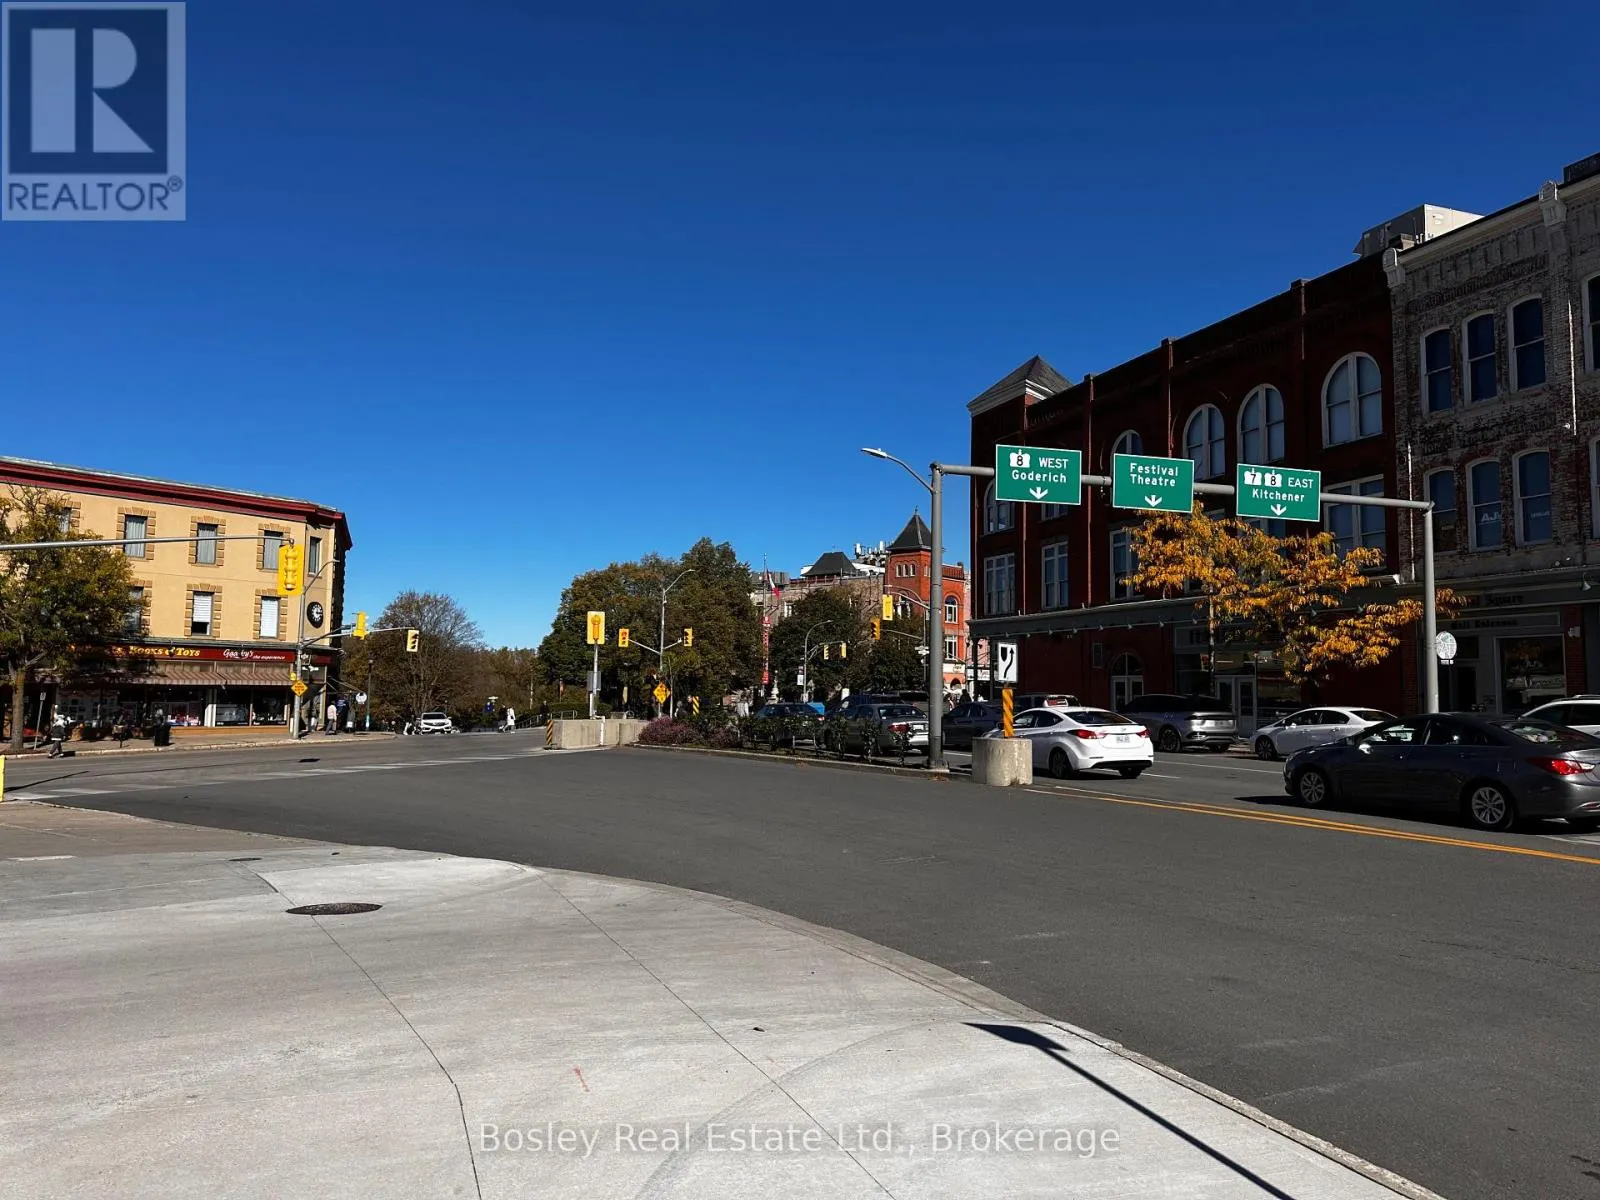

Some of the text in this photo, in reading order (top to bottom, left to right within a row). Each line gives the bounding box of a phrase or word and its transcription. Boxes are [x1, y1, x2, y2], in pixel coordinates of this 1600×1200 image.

[1016, 455, 1069, 469] 8 WEST
[1011, 469, 1067, 483] Goderich
[1130, 462, 1178, 477] Festival
[1130, 473, 1176, 487] Theatre
[1250, 473, 1314, 489] 7 8 EAST
[1252, 488, 1305, 502] Kitchener
